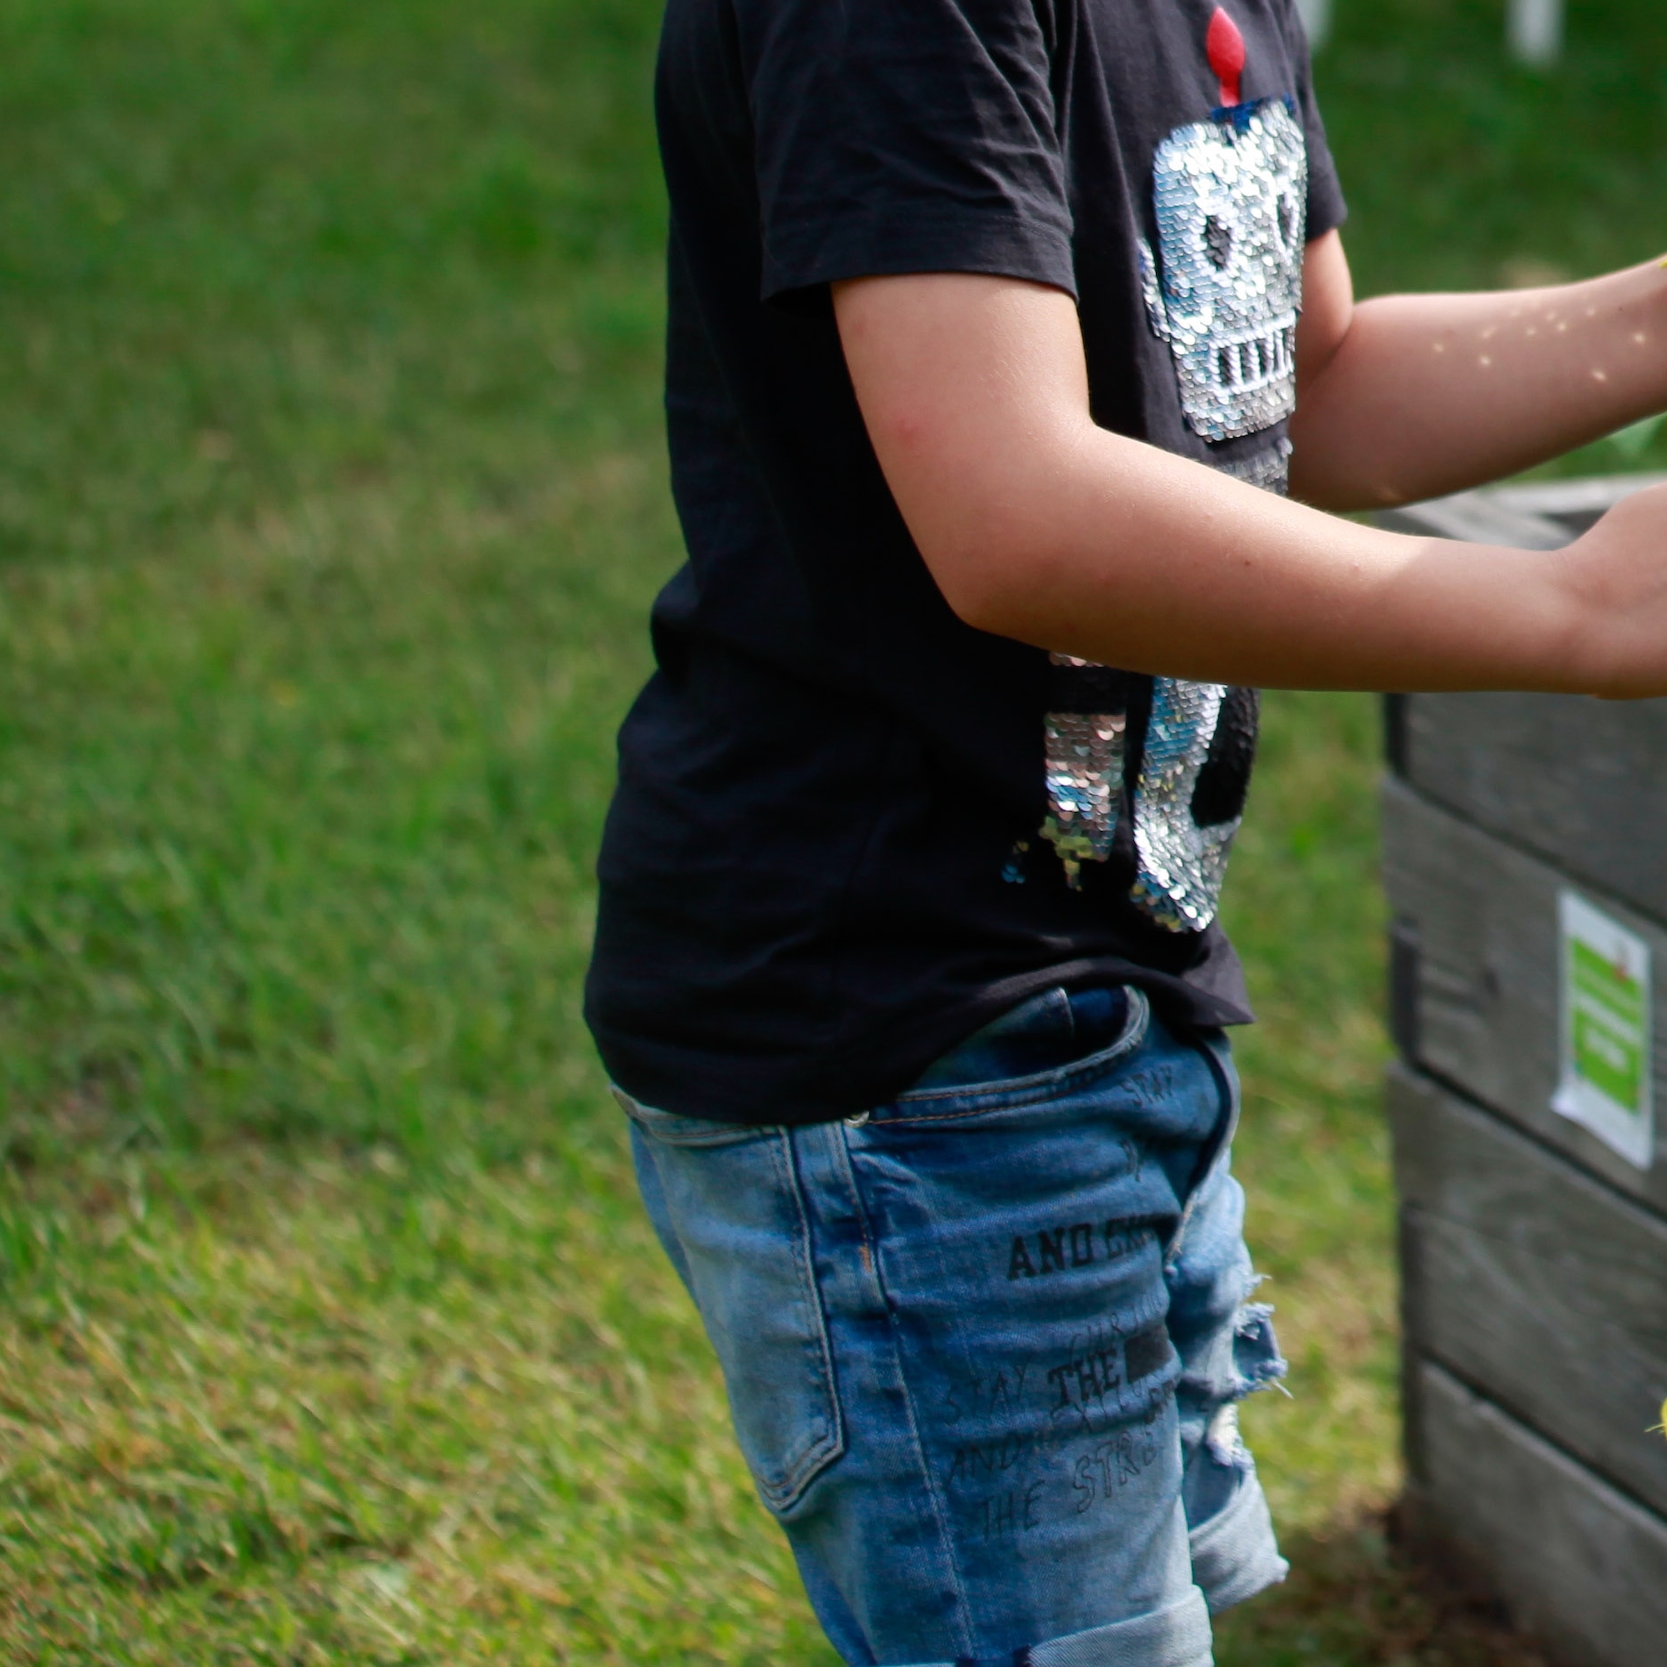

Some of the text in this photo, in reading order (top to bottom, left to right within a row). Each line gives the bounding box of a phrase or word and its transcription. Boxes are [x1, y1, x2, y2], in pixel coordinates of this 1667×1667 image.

[1007, 1223, 1093, 1281] AND
[1047, 1347, 1121, 1405] THE
[979, 1479, 1046, 1545] THE
